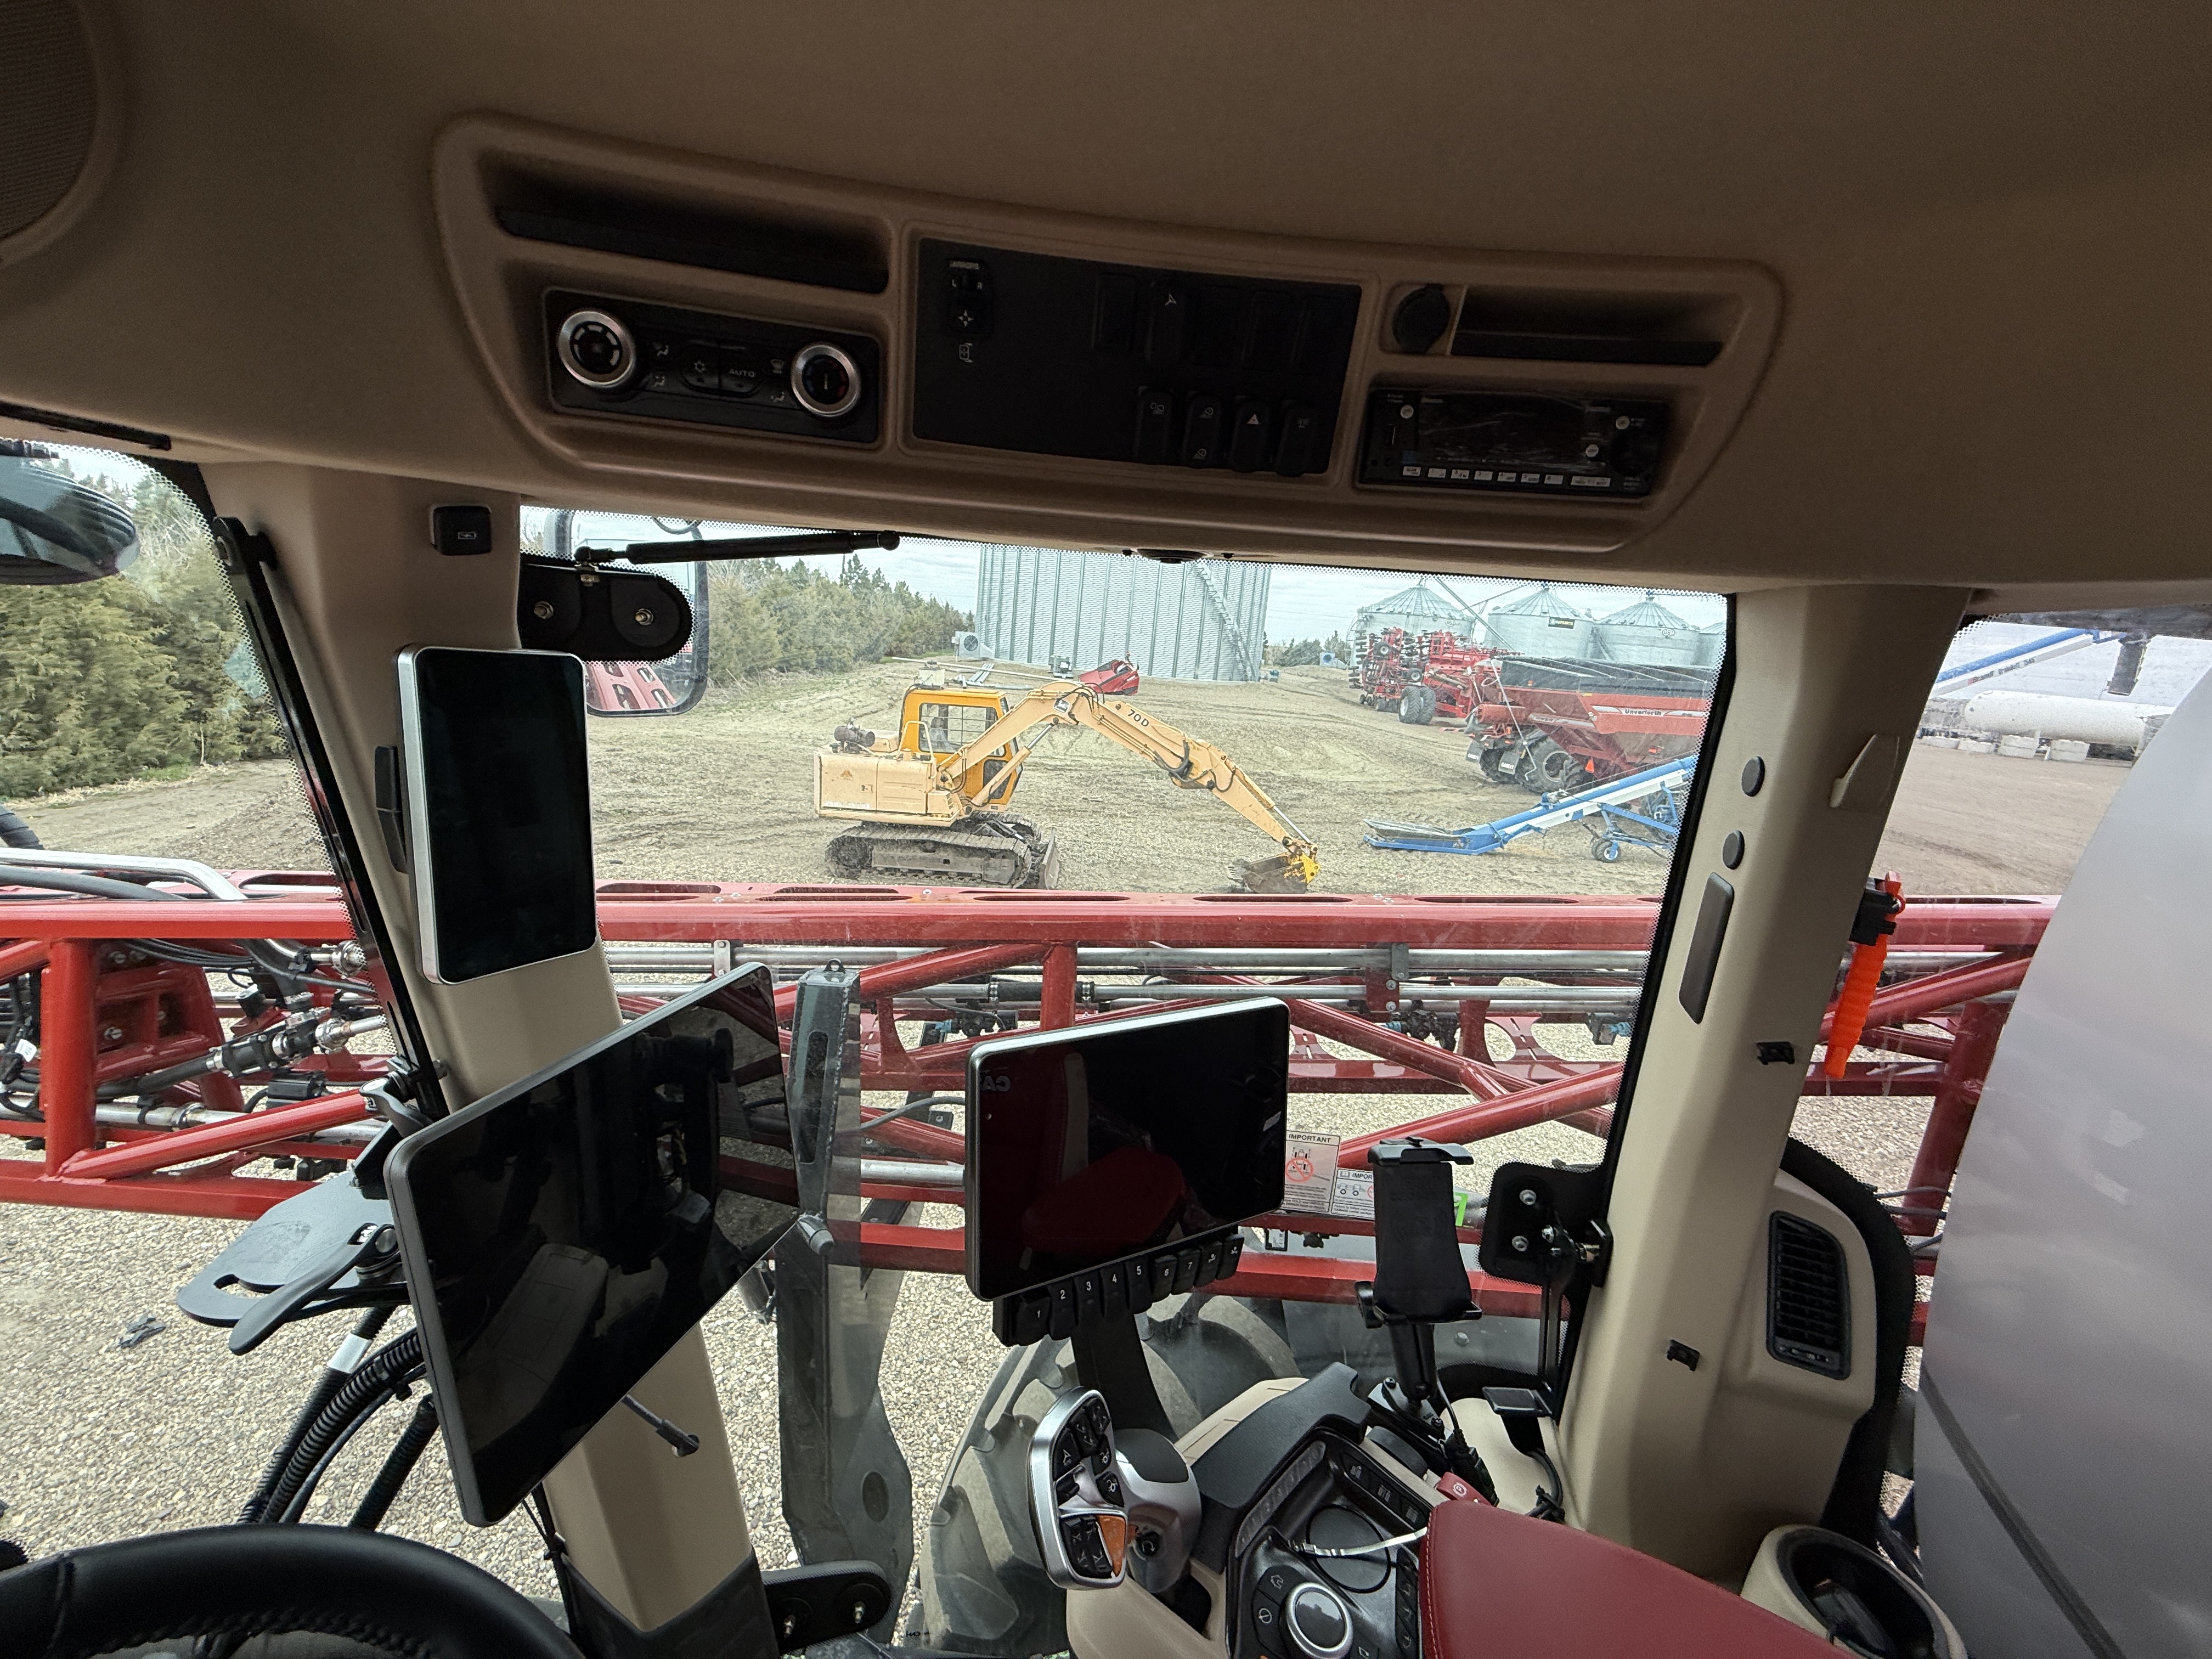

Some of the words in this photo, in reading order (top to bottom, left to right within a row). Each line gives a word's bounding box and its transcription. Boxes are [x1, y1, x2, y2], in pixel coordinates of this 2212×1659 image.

[728, 368, 755, 377] AUTO
[1127, 709, 1149, 727] 70D
[1289, 1133, 1331, 1143] IMPORTANT
[1188, 1261, 1193, 1269] 7
[1137, 1265, 1142, 1276] 5
[1112, 1273, 1117, 1283] 4
[1086, 1281, 1092, 1291] 3
[1060, 1290, 1066, 1300] 2
[1037, 1310, 1041, 1318] 1
